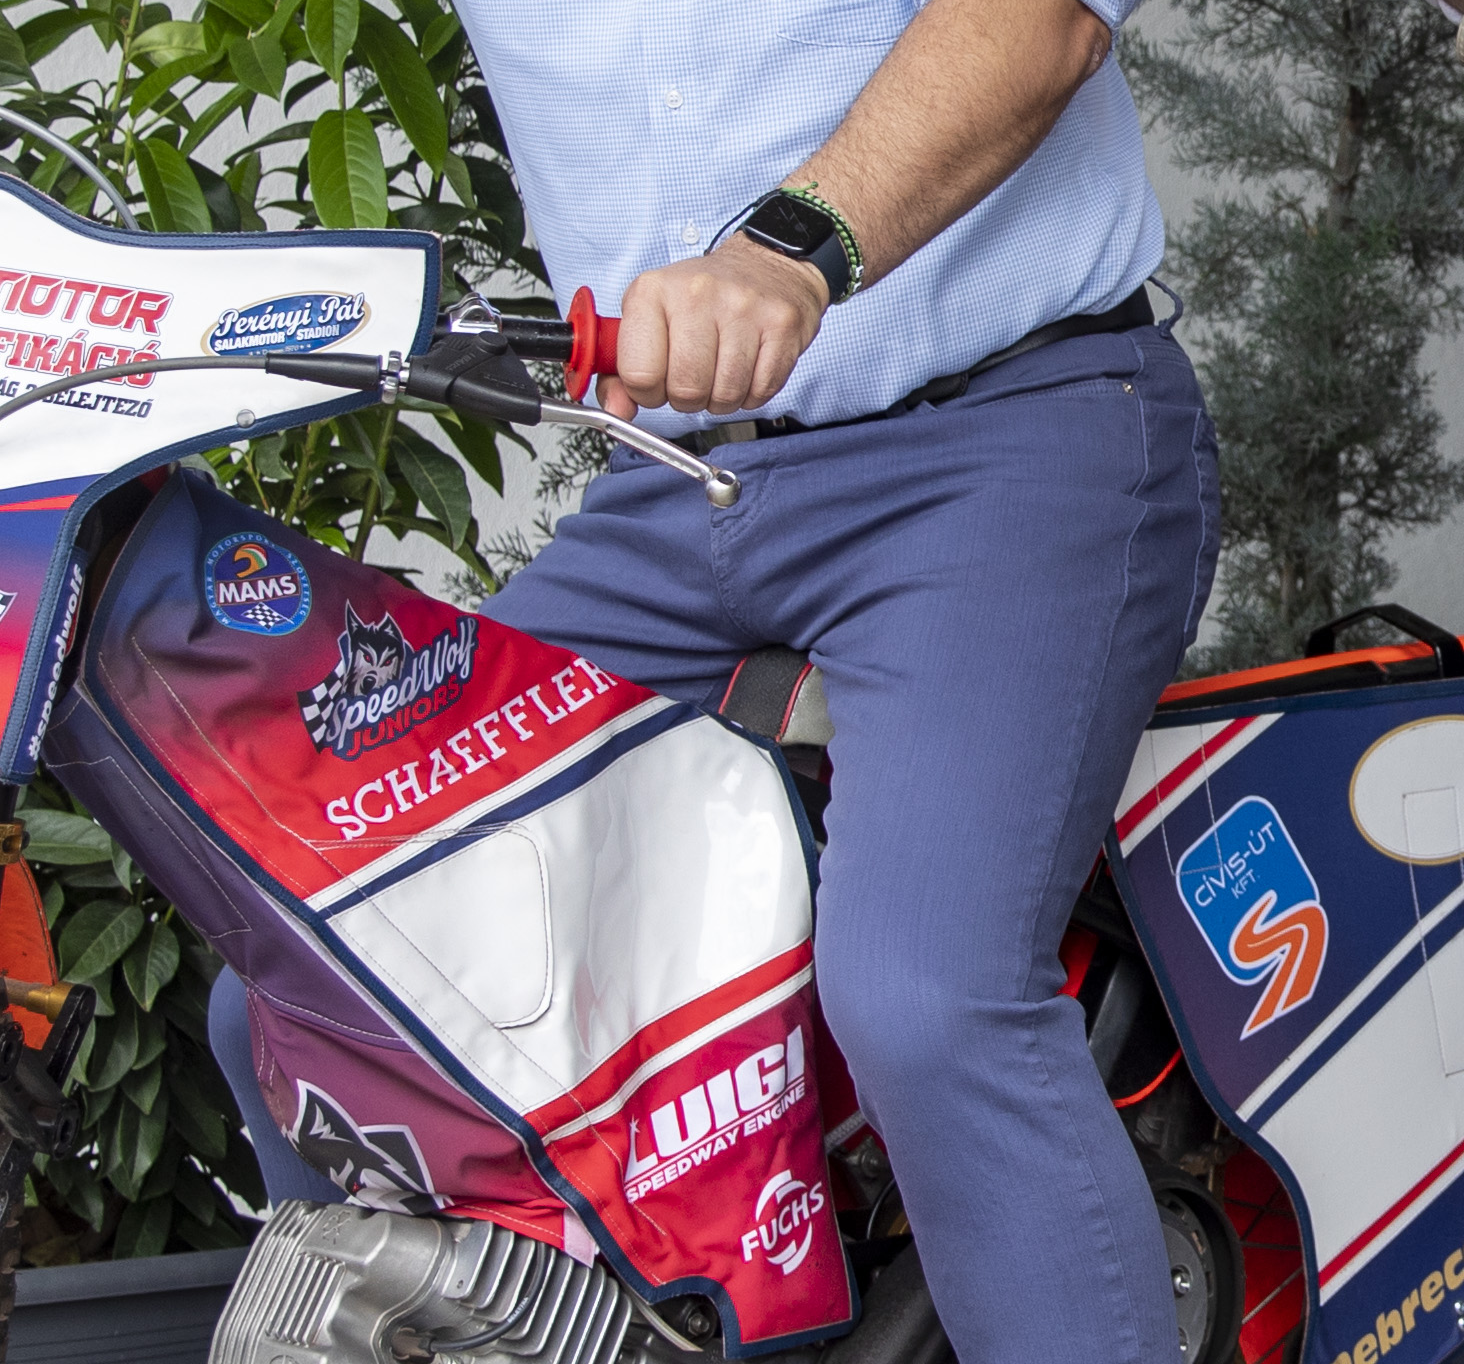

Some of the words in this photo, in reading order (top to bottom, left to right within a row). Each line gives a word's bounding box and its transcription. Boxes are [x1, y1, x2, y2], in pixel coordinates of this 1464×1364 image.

[214, 331, 286, 352] SALAKMOTOR
[297, 324, 340, 341] STADION
[215, 303, 312, 336] Perényi
[318, 292, 365, 324] Pál
[219, 575, 297, 604] MAMS
[29, 563, 84, 762] #speedwolf
[326, 617, 478, 751] SpeedWolf
[326, 656, 618, 841] SCHAEFFLER
[346, 680, 460, 757] JUNIORS
[1195, 821, 1275, 907] CÍVIS-ÚT
[624, 1024, 806, 1183] LUIGI
[625, 1127, 740, 1205] SPEEDWAY
[743, 1082, 806, 1138] ENGINE
[740, 1181, 825, 1263] FUCHS
